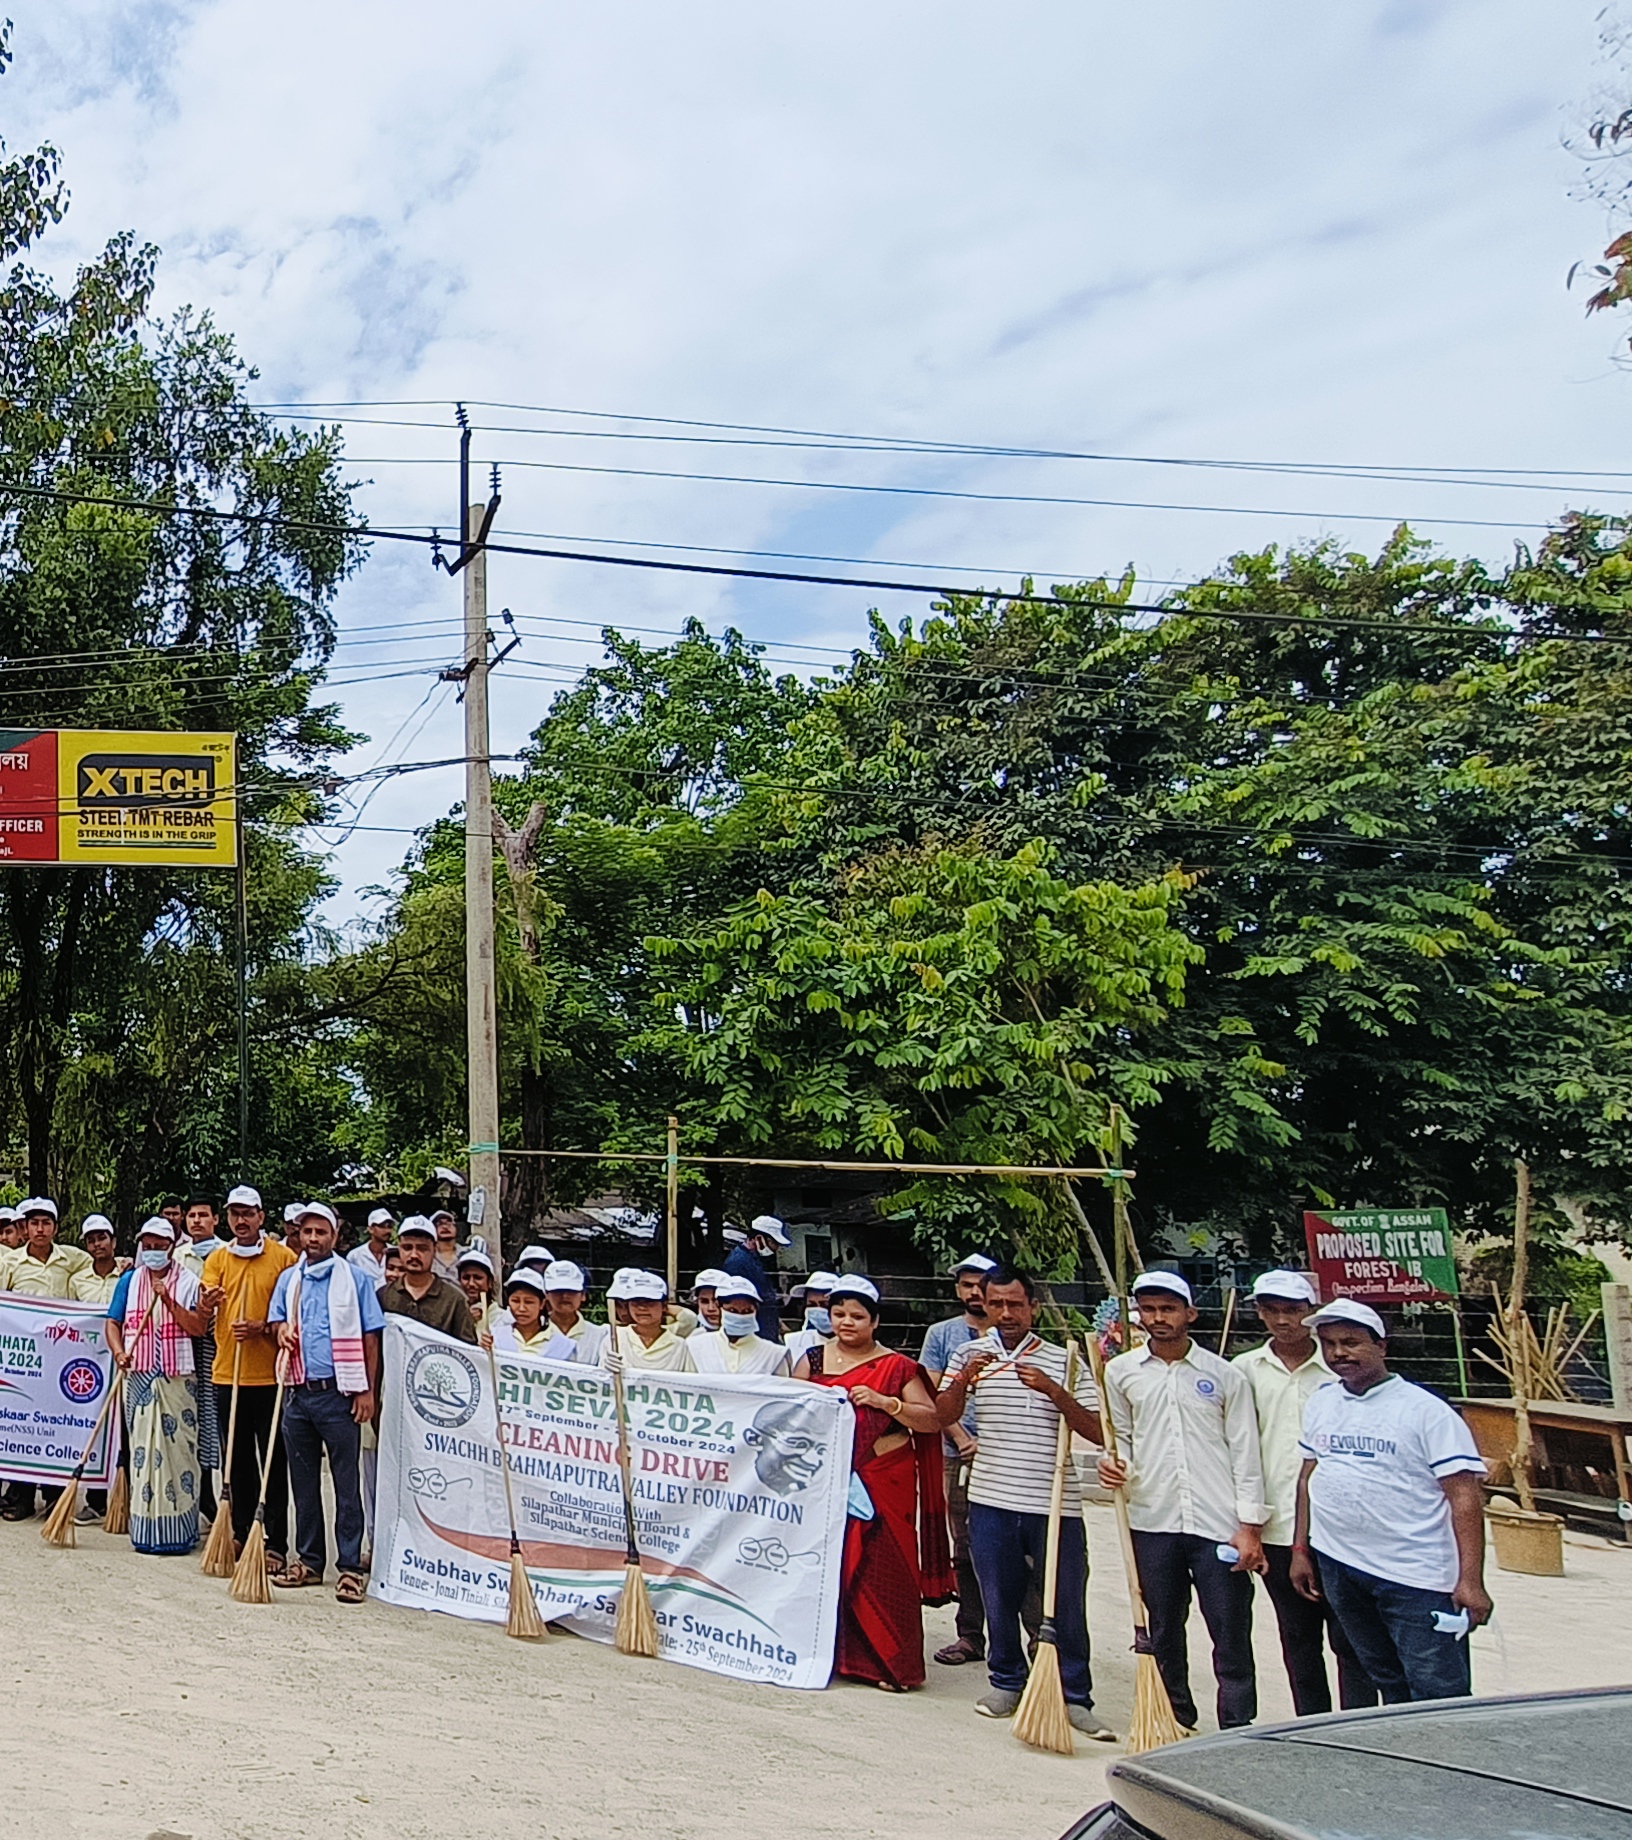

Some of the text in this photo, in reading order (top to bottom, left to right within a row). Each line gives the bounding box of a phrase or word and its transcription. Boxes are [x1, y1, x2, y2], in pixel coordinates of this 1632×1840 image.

[82, 767, 207, 799] XTECH
[80, 810, 214, 827] STEEL TMT REBAR
[78, 830, 216, 840] STRENGTH IS IN THE GRIP
[1392, 1214, 1432, 1226] ASSAM
[1316, 1230, 1446, 1260] PROPOSED SITE FOR
[1344, 1260, 1423, 1279] FOREST IB
[8, 1353, 42, 1369] 2024
[33, 1411, 97, 1428] Swachhata
[498, 1382, 532, 1406] HI
[645, 1409, 736, 1440] 2024
[36, 1428, 56, 1438] Unit
[525, 1410, 599, 1430] September
[637, 1430, 694, 1448] October
[698, 1441, 736, 1454] 2024
[424, 1432, 488, 1464] SWACHH
[492, 1450, 621, 1494] BRAHMAPUTRA
[692, 1488, 804, 1525] FOUNDATION
[640, 1448, 730, 1482] DRIVE
[520, 1496, 580, 1520] Silapathar
[643, 1521, 680, 1537] Board
[682, 1528, 691, 1539] &
[530, 1512, 588, 1536] Silapathar
[638, 1534, 681, 1554] College
[402, 1549, 482, 1585] Swabhav
[682, 1614, 798, 1666] Swachhata
[706, 1646, 765, 1676] September
[766, 1666, 793, 1682] 2024
